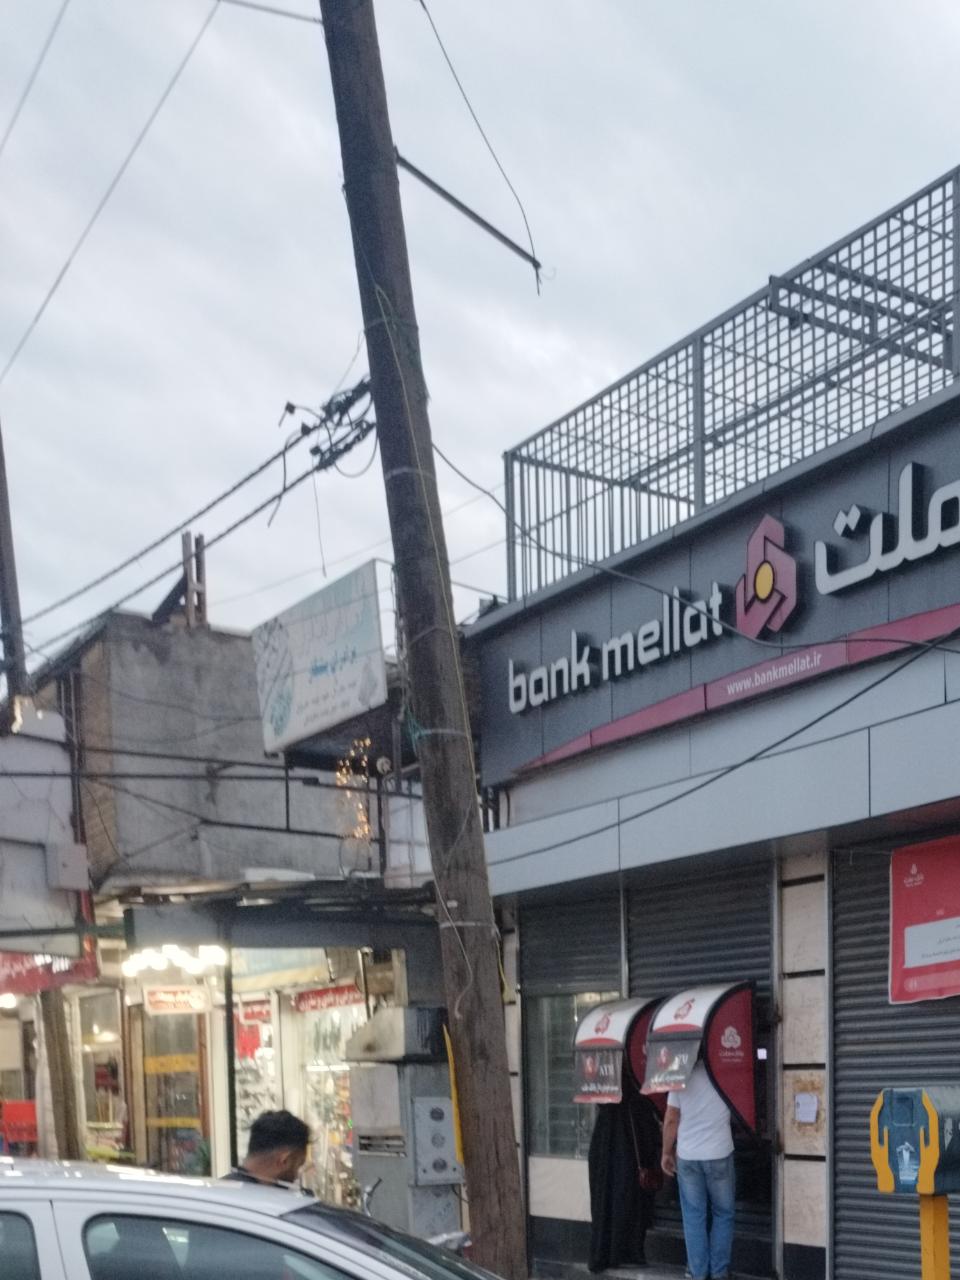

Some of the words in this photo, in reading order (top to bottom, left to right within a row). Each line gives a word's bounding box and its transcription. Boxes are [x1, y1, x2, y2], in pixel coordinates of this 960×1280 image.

[508, 629, 590, 714] bank
[602, 581, 723, 681] mellat
[727, 651, 822, 695] www.bankmellat.ir
